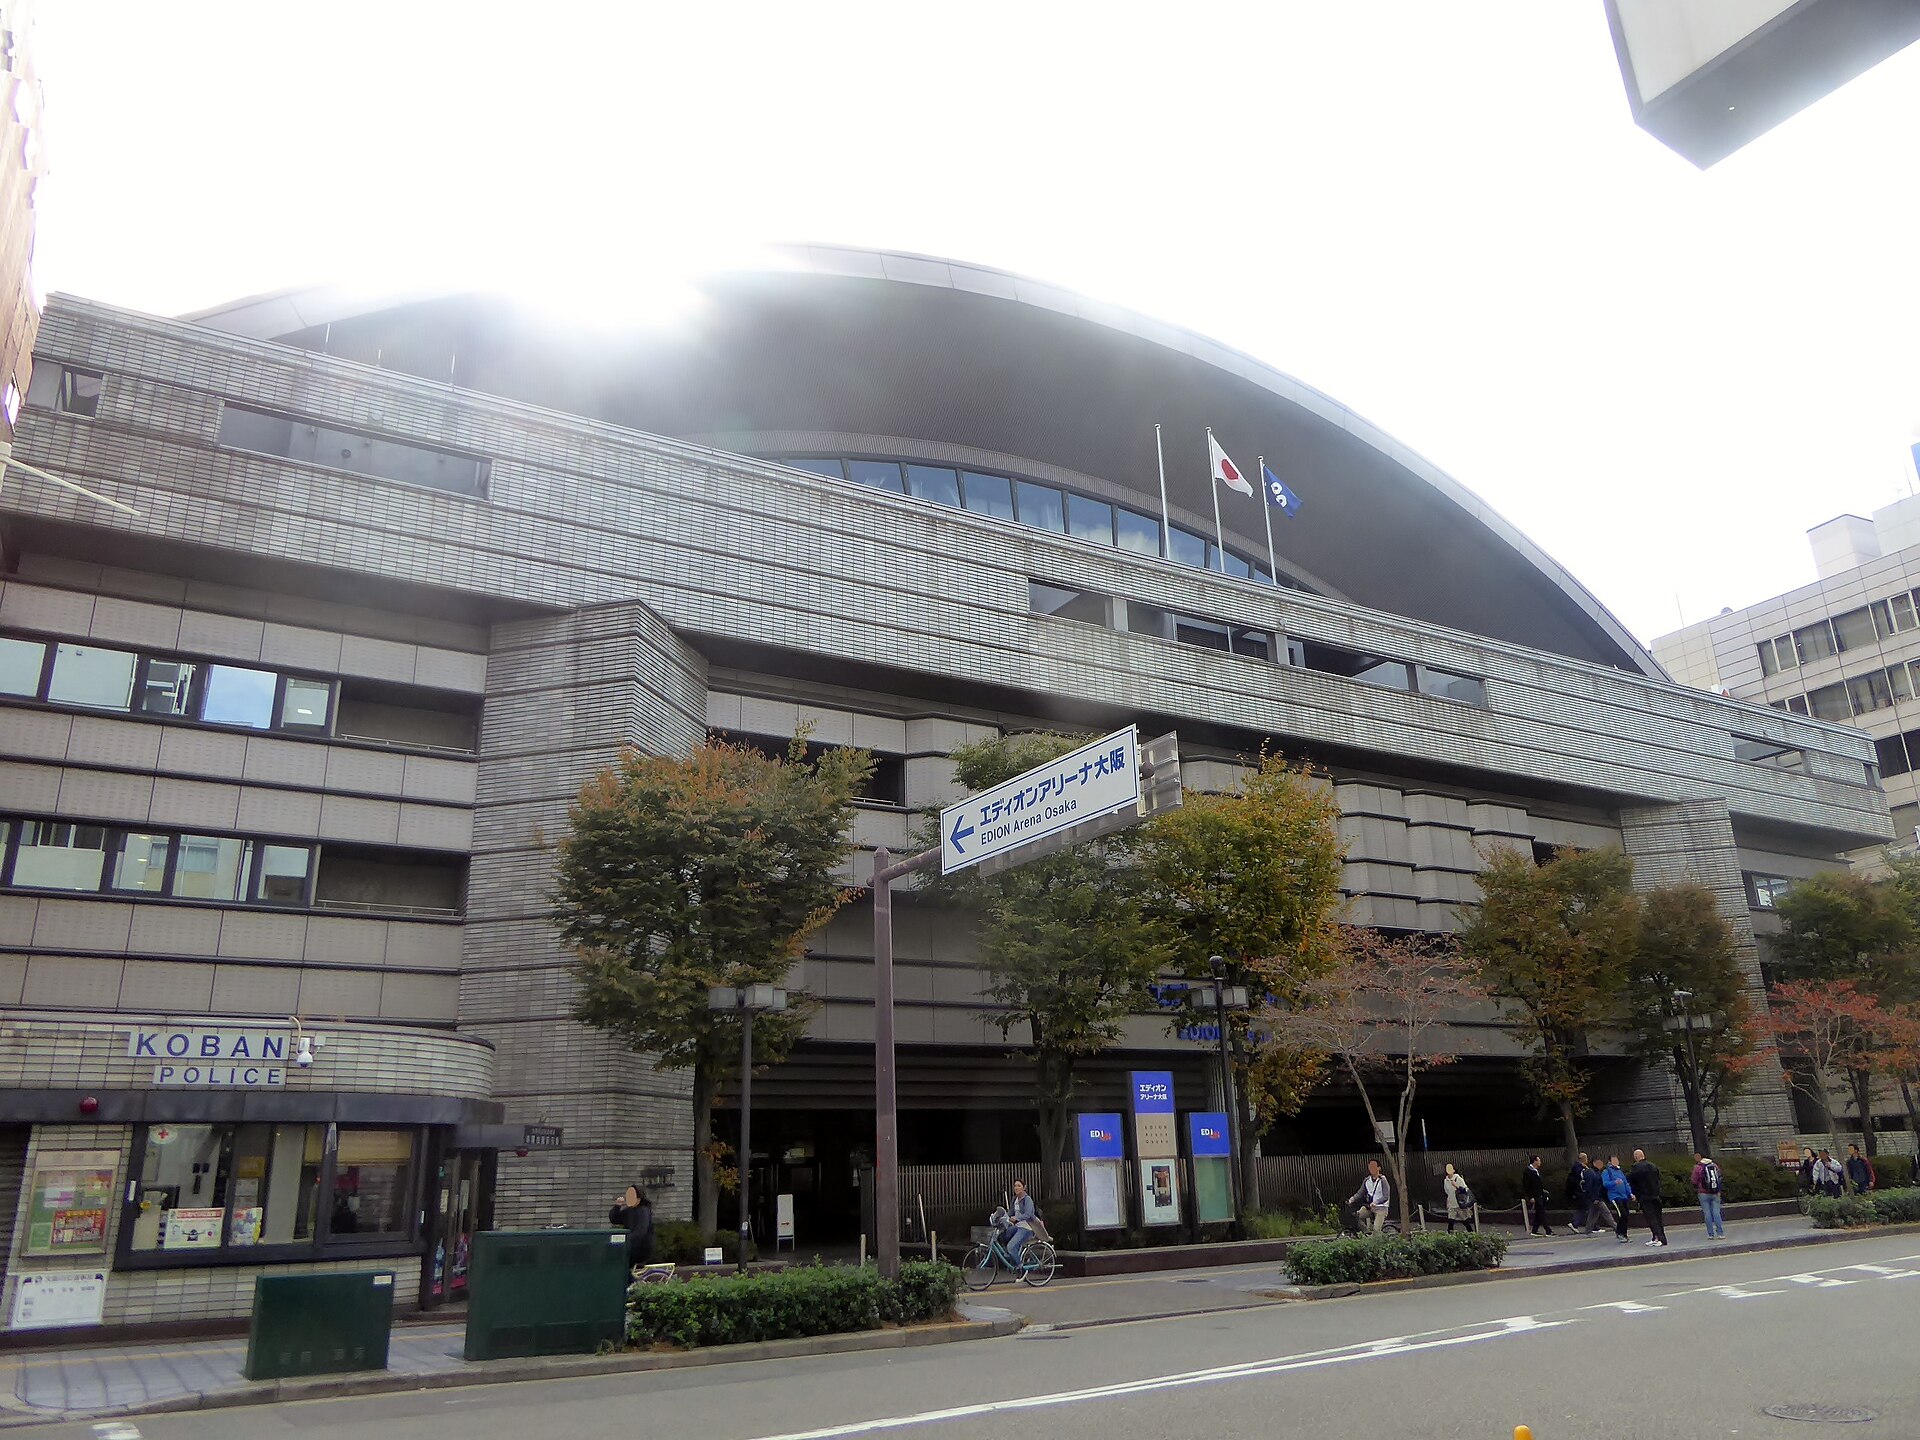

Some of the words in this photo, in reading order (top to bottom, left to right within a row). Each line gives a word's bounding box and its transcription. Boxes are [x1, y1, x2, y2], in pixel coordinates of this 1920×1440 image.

[980, 746, 1125, 826] エディオンアリーナ大阪
[981, 823, 1010, 845] EDION
[1013, 813, 1042, 833] Arena
[1045, 799, 1077, 820] Osaka
[136, 1033, 283, 1058] KOBAN
[159, 1067, 281, 1084] POLICE
[1139, 1084, 1167, 1092] エディオン
